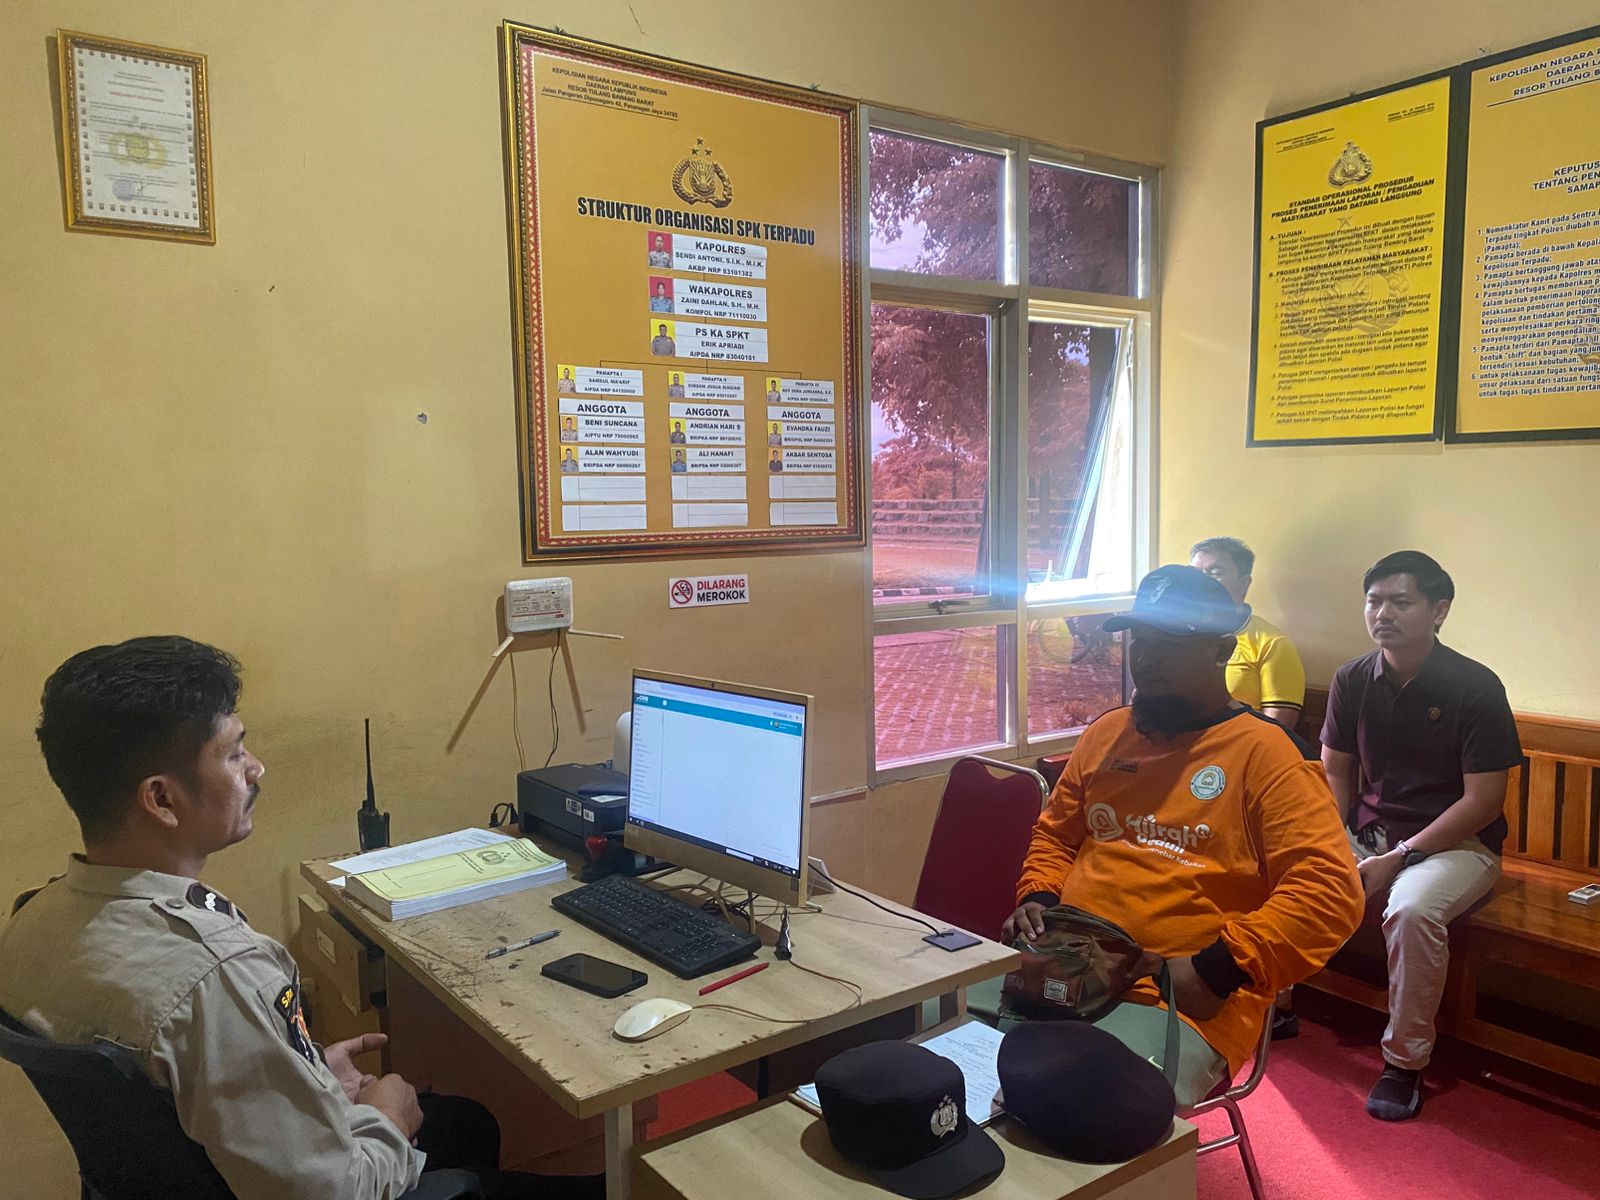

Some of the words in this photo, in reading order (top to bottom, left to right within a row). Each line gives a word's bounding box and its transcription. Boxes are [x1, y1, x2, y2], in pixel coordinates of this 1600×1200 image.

[1489, 62, 1547, 83] KEPOLISIAN
[1550, 50, 1593, 67] NEGARA
[1546, 61, 1588, 78] DAERAH
[552, 67, 585, 79] KEPOLISIAN
[587, 74, 610, 84] NEGARA
[611, 79, 638, 89] REPUBLIK
[639, 85, 667, 96] INDONESIA
[586, 81, 609, 90] DAERAH
[610, 86, 636, 96] LAMPUNG
[1513, 82, 1546, 96] RESOR
[1549, 71, 1590, 87] TULANG
[542, 86, 556, 94] Jalan
[558, 90, 583, 100] Pangeran
[567, 84, 587, 93] RESOR
[588, 89, 610, 97] TULANG
[612, 93, 635, 102] BAWANG
[636, 98, 654, 106] BARAT
[1533, 175, 1578, 190] TENTANG
[1271, 208, 1297, 218] PROSES
[1300, 198, 1345, 212] PENERIMAAN
[1347, 190, 1381, 202] LAPORAN
[1387, 179, 1434, 194] PENGADUAN
[1289, 196, 1320, 207] STANDAR
[1322, 186, 1372, 201] OPERASIONAL
[1373, 176, 1414, 190] PROSEDUR
[1280, 208, 1327, 223] MASYARAKAT
[1329, 204, 1347, 213] YANG
[1349, 198, 1378, 209] DATANG
[1380, 188, 1422, 202] LANGSUNG
[577, 197, 651, 224] STRUKTUR
[655, 208, 733, 235] ORGANISASI
[736, 219, 760, 238] SPK
[764, 223, 815, 246] TERPADU
[1485, 221, 1528, 234] Nomenklatur
[1531, 218, 1549, 226] Kanit
[1552, 215, 1569, 224] pada
[1572, 209, 1595, 220] Sentra
[1277, 230, 1302, 238] TUJUAN
[1485, 234, 1512, 244] Terpadu
[1513, 229, 1538, 240] tingkat
[1541, 225, 1563, 234] Polres
[1565, 220, 1590, 230] diubah
[695, 241, 746, 255] KAPOLRES
[1484, 241, 1520, 253] (Pamapta);
[1484, 252, 1513, 262] Pamapta
[1516, 247, 1540, 256] berada
[1551, 242, 1574, 251] bawah
[675, 251, 696, 260] SENDI
[697, 254, 724, 264] ANTONI,
[1276, 268, 1299, 276] PROSES
[1301, 261, 1341, 272] PENERIMAAN
[1343, 255, 1380, 265] PELAYANAN
[1382, 246, 1427, 258] MASYARAKAT
[1483, 260, 1518, 271] Kepolisian
[1521, 255, 1552, 266] Terpadu;
[687, 264, 706, 272] AKBP
[1484, 270, 1513, 280] Pamapta
[1515, 264, 1559, 276] bertanggung
[1562, 260, 1584, 270] jawab
[1483, 277, 1529, 290] kewajibannya
[1531, 273, 1557, 283] kepada
[1559, 268, 1591, 279] Kapolres
[689, 284, 752, 299] WAKAPOLRES
[1483, 289, 1512, 298] Pamapta
[1514, 285, 1545, 295] bertugas
[1547, 278, 1592, 289] memberikan
[680, 296, 699, 304] ZAINI
[701, 298, 729, 307] DAHLAN,
[746, 302, 760, 310] M.H.
[1482, 299, 1502, 307] dalam
[1504, 296, 1527, 304] bentuk
[1529, 291, 1572, 302] penerimaan
[685, 307, 712, 316] KOMPOL
[1481, 306, 1524, 317] pelaksanaan
[1526, 301, 1563, 311] pemberian
[1481, 316, 1516, 325] kepolisian
[1533, 310, 1564, 319] tindakan
[1566, 307, 1597, 317] pertama
[695, 327, 707, 336] PS
[710, 329, 723, 338] KA
[725, 330, 749, 339] SPKT
[1500, 321, 1552, 333] menyelesaikan
[1554, 318, 1582, 327] perkara
[1480, 332, 1544, 344] menyelenggarakan
[1547, 326, 1596, 338] pengendalian
[689, 350, 710, 358] AIPDA
[1543, 348, 1567, 357] bagian
[1569, 347, 1586, 355] yang
[1479, 362, 1512, 370] tersendiri
[1539, 356, 1579, 365] kebutuhan;
[1499, 387, 1540, 396] tugas-tugas
[577, 404, 626, 413] ANGGOTA
[685, 407, 729, 416] ANGGOTA
[781, 410, 821, 419] ANGGOTA
[696, 578, 746, 591] DILARANG
[696, 590, 746, 602] MEROKOK
[1125, 814, 1198, 848] Hijrah
